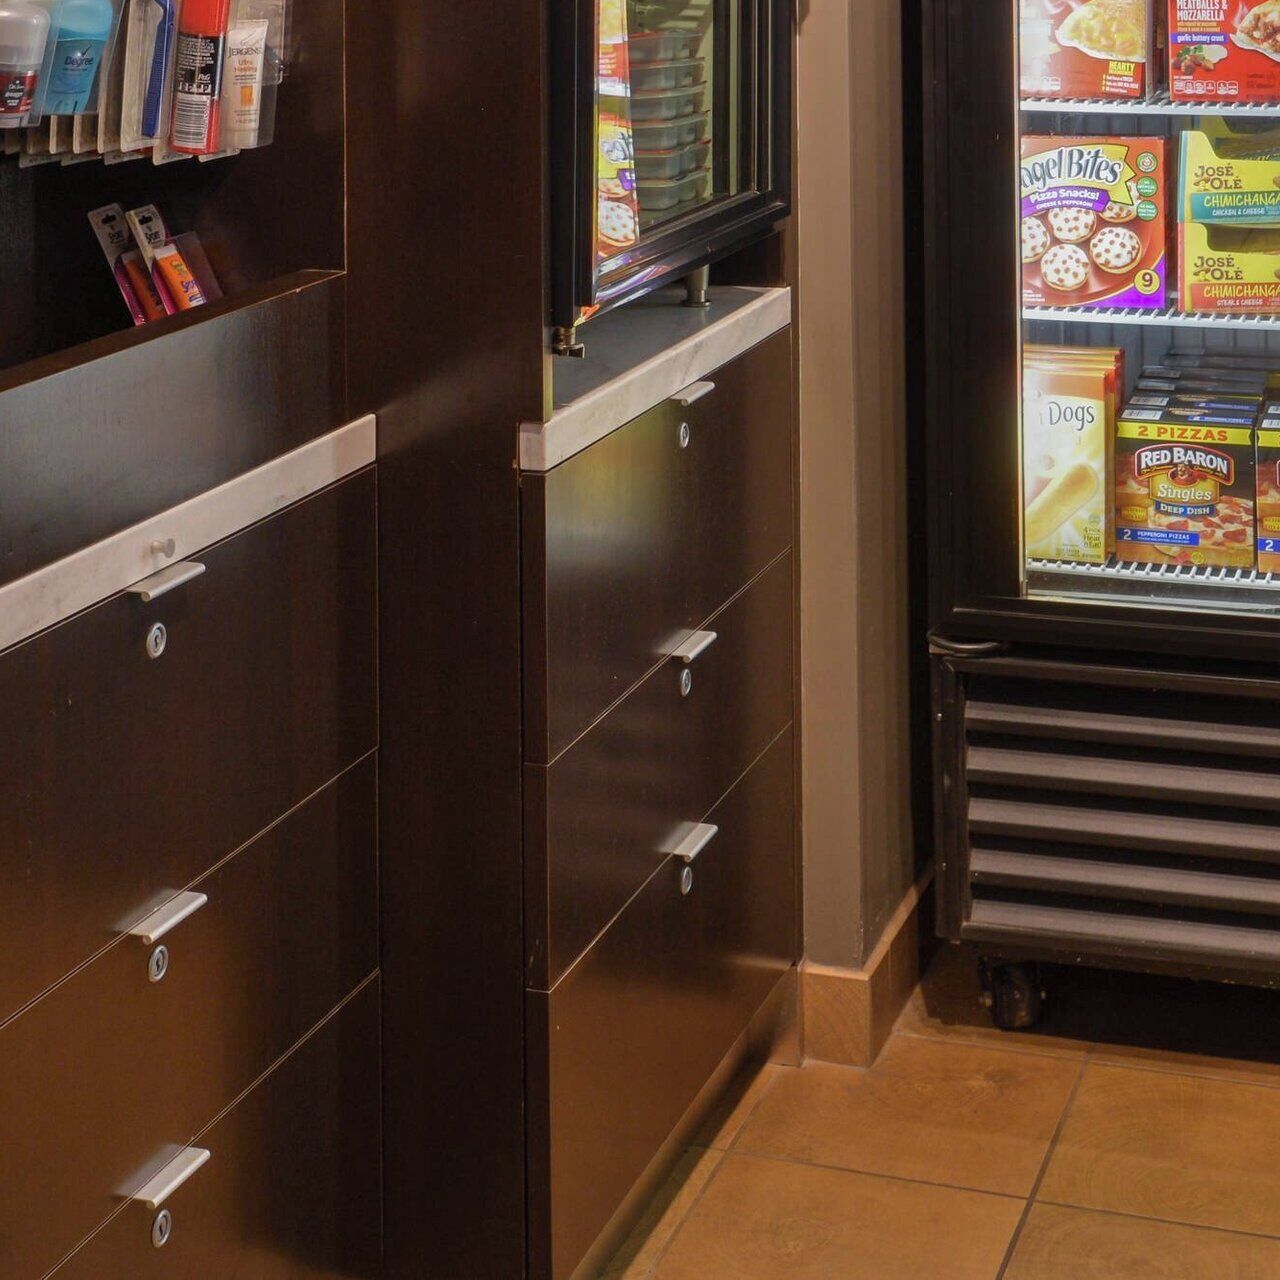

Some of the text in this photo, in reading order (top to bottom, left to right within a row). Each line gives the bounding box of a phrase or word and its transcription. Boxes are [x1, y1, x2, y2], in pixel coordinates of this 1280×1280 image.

[1176, 0, 1228, 9] MEATBALLS &
[1176, 10, 1225, 20] MOZZARELLA
[228, 47, 262, 57] JERGENS
[64, 55, 94, 68] Degree
[1067, 148, 1122, 183] Bites
[1194, 163, 1234, 178] JOSÉ
[1210, 177, 1242, 190] OLÉ
[1030, 189, 1099, 203] Pizza Snacks!
[1194, 255, 1235, 268] JOSÉ
[1141, 272, 1154, 287] 9
[1210, 267, 1243, 280] OLÉ
[1048, 401, 1095, 431] Dogs
[1138, 426, 1228, 441] 2 PIZZAS
[1140, 447, 1228, 474] RED BARON
[1158, 484, 1212, 502] Singles
[1160, 504, 1210, 514] DEEP DISH
